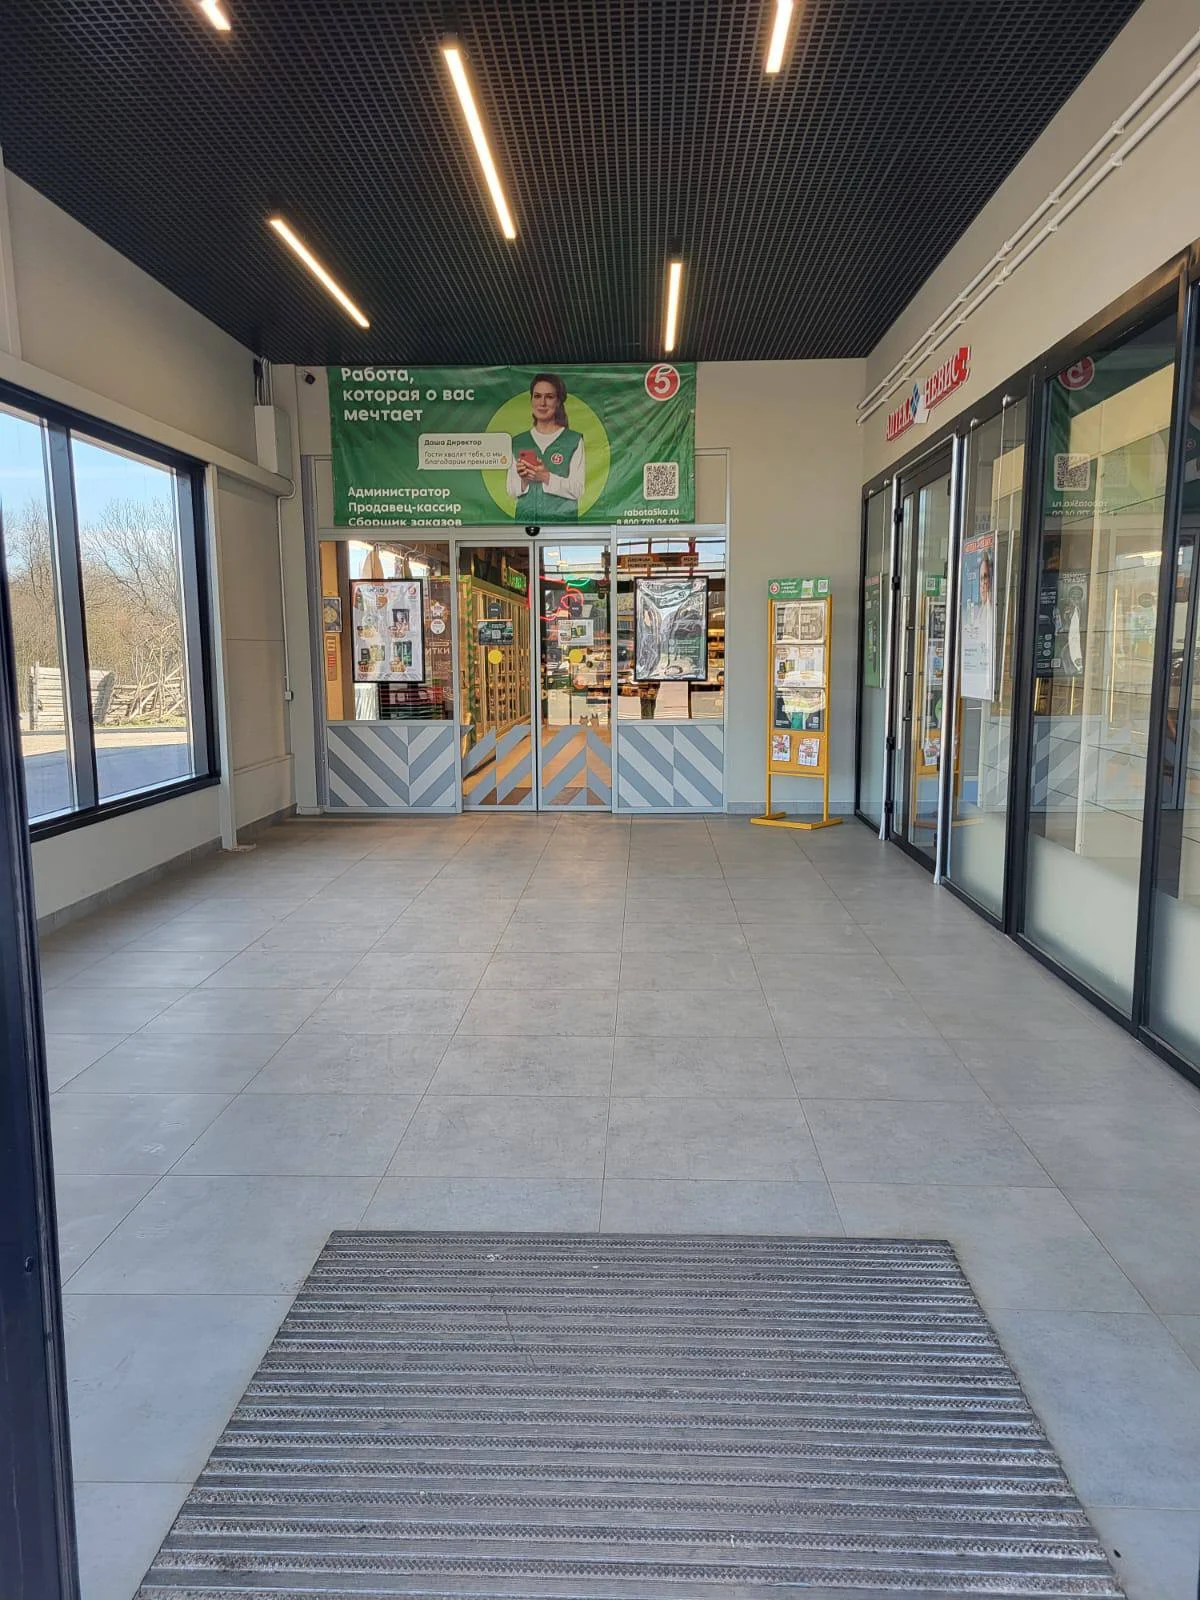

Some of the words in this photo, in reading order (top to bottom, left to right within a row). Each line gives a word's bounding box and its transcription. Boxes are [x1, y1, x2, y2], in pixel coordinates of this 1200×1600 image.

[341, 367, 414, 384] Работа,
[343, 389, 420, 405] которая
[426, 389, 437, 401] о
[443, 388, 475, 401] вас
[887, 397, 914, 440] АПТЕКА
[925, 346, 970, 409] НЕВИС
[344, 409, 423, 421] мечтает
[347, 487, 450, 499] Администратор
[348, 502, 462, 514] Продавец-кассир
[624, 508, 680, 517] rabota5ka.ru
[425, 647, 450, 655] ИТКИ
